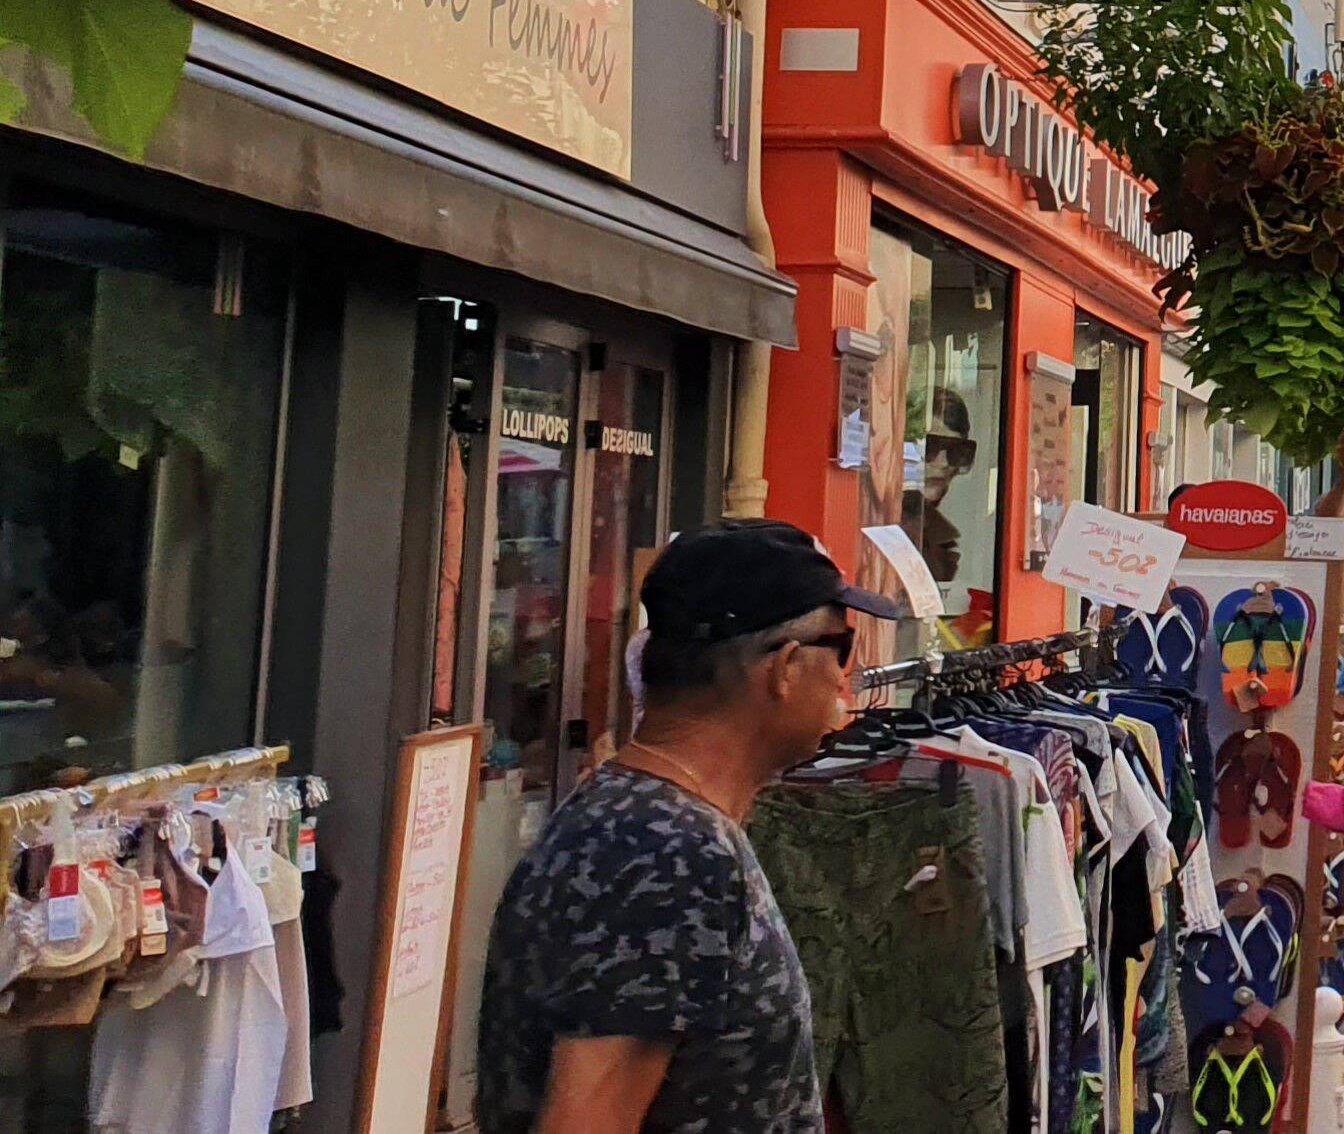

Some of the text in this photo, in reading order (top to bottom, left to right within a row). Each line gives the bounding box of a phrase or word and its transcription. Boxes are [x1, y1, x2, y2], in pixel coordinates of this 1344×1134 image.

[974, 62, 1091, 212] OPTIQUE
[502, 408, 570, 444] LOLLIPOPS
[601, 425, 654, 457] DESIGUAL
[1179, 503, 1275, 526] havaianas
[1088, 547, 1158, 576] -50%
